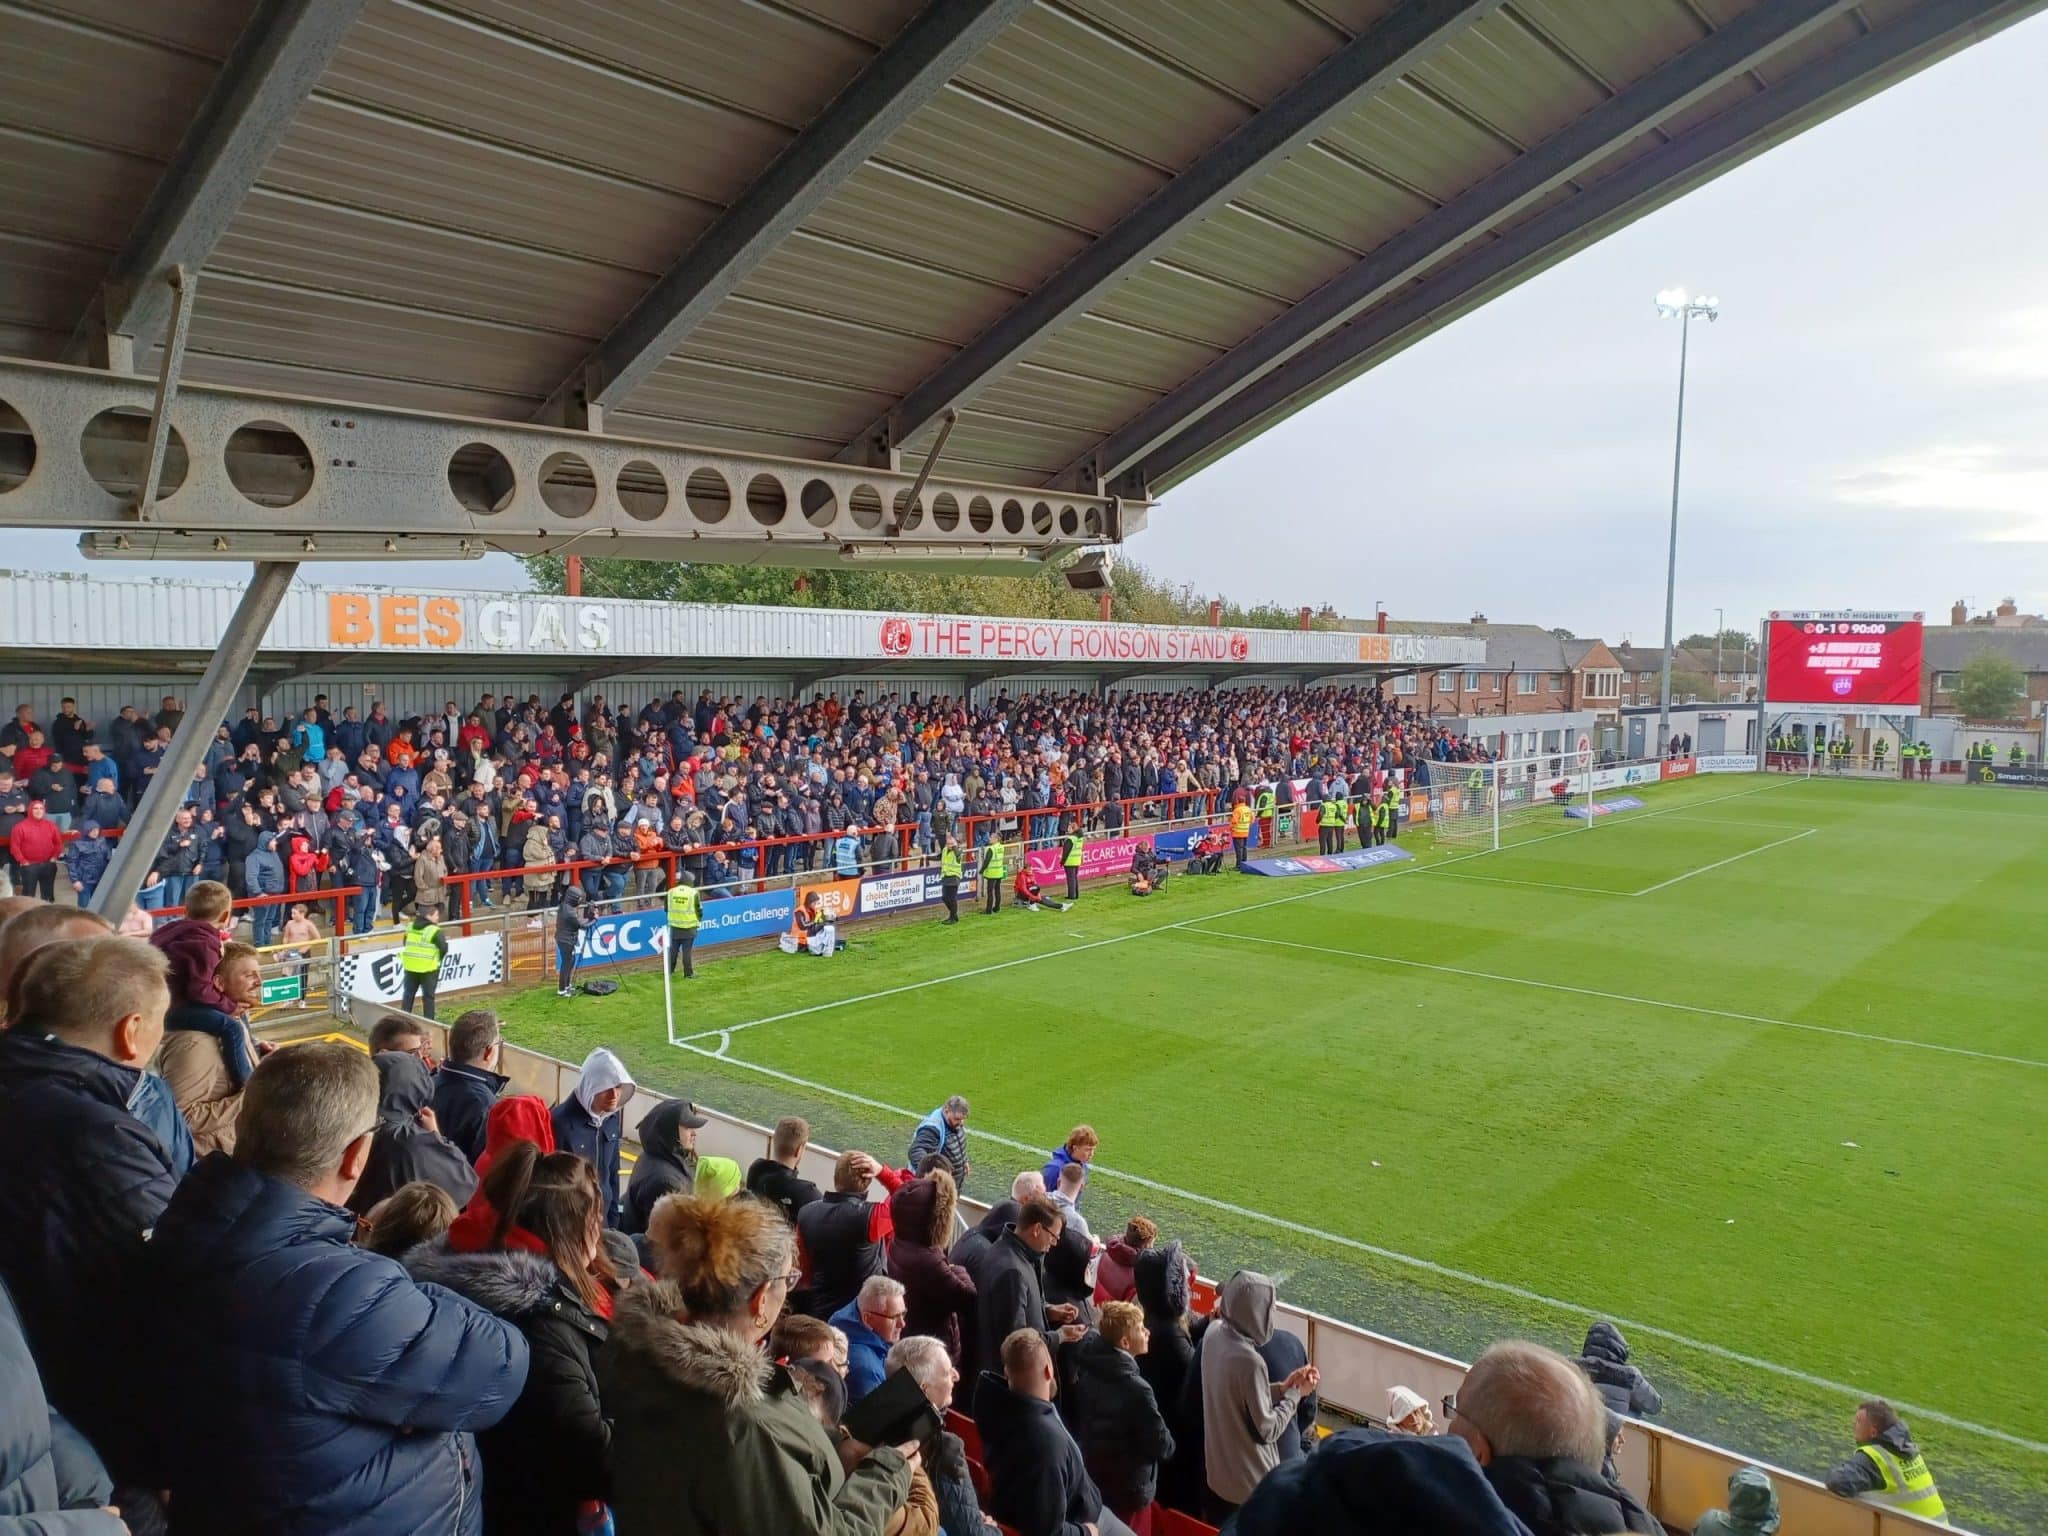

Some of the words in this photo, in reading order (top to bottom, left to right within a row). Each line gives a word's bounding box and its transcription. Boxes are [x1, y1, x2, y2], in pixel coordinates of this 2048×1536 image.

[328, 593, 462, 648] BES
[479, 600, 610, 649] GAS
[1851, 624, 1886, 634] 90:00
[918, 622, 971, 655] THE
[981, 624, 1063, 657] PERCY
[1071, 629, 1160, 659] RONSON
[1167, 632, 1227, 659] STAND
[1360, 636, 1390, 661] BES
[1393, 638, 1425, 661] GAS
[865, 890, 889, 902] choice
[889, 888, 900, 897] for
[902, 884, 920, 895] small
[875, 881, 889, 890] The
[890, 878, 911, 888] smart
[874, 896, 913, 908] businesses
[721, 914, 741, 927] Our
[742, 906, 790, 922] Challenge
